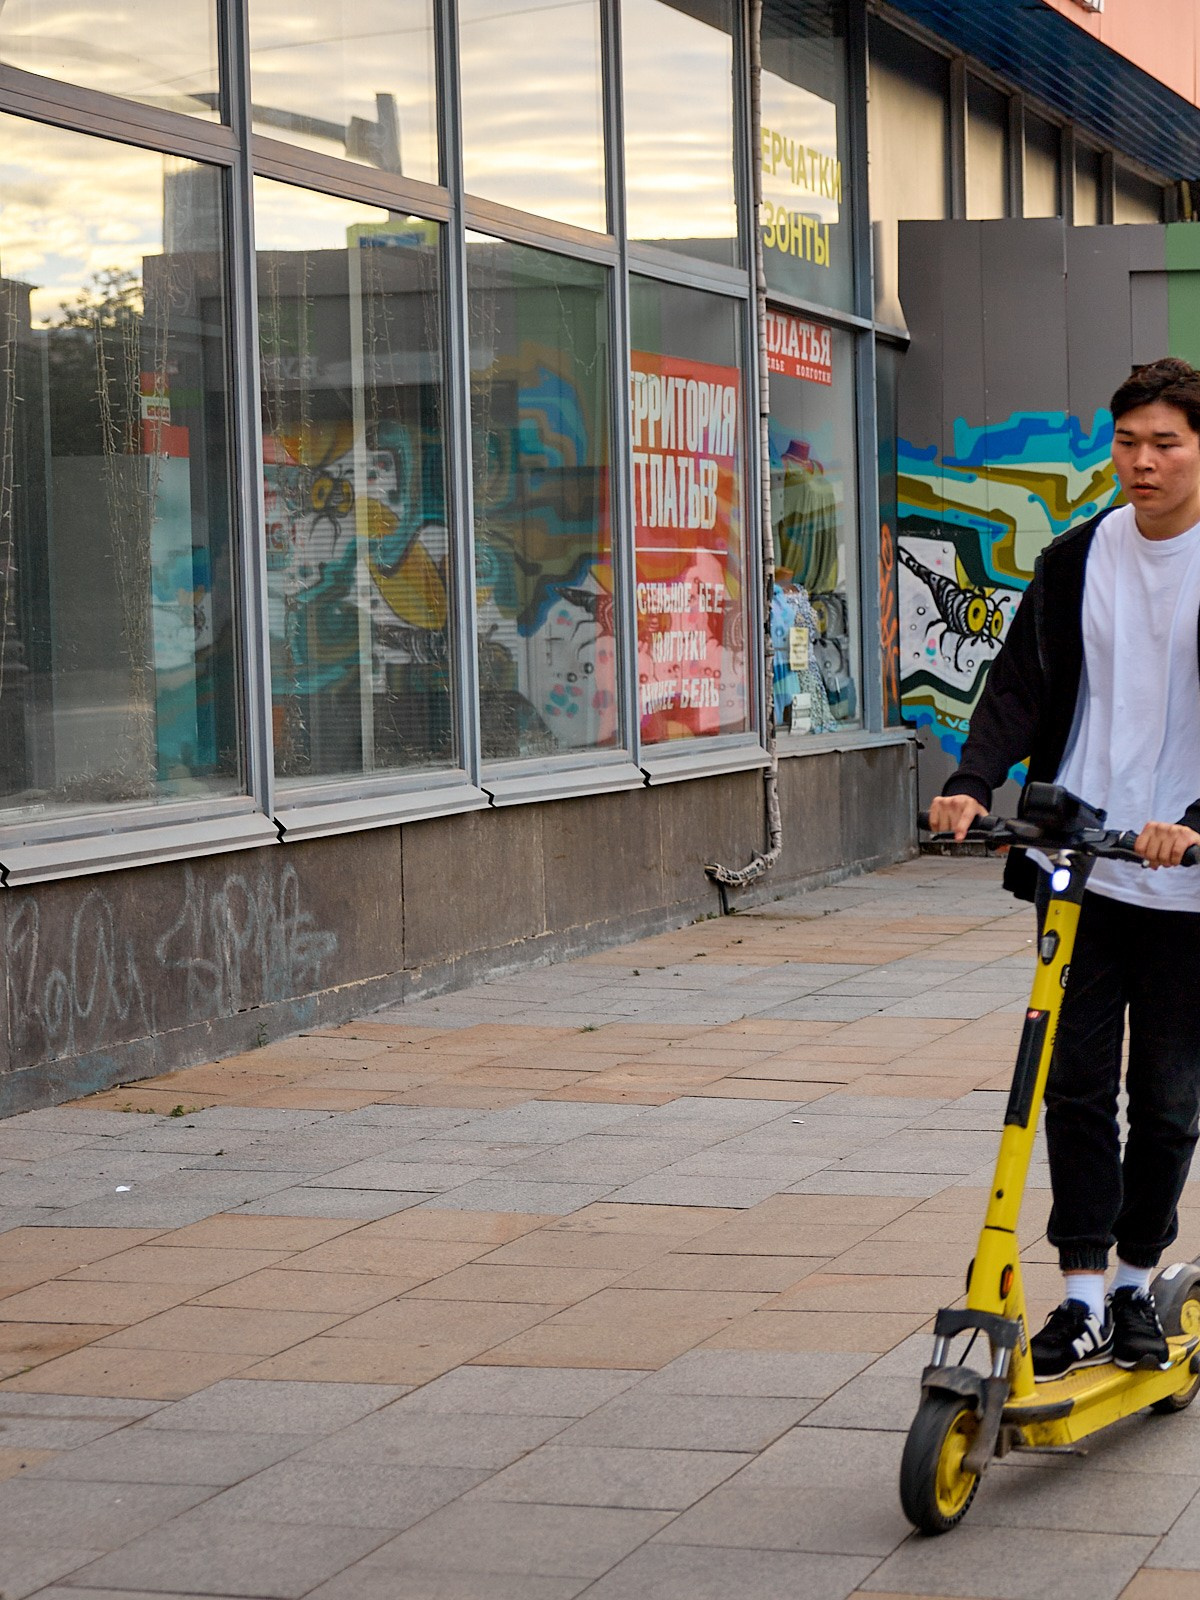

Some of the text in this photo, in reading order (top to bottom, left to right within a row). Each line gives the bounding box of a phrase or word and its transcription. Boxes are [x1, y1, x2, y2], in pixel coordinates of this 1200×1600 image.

[763, 201, 830, 268] ЗОНТЫ
[766, 312, 831, 366] ПЛАТЬЯ
[796, 364, 832, 383] КОЛГОТКИ
[632, 452, 718, 530] ПЛАТЬЕВ
[652, 630, 707, 664] КОЛГОТКИ
